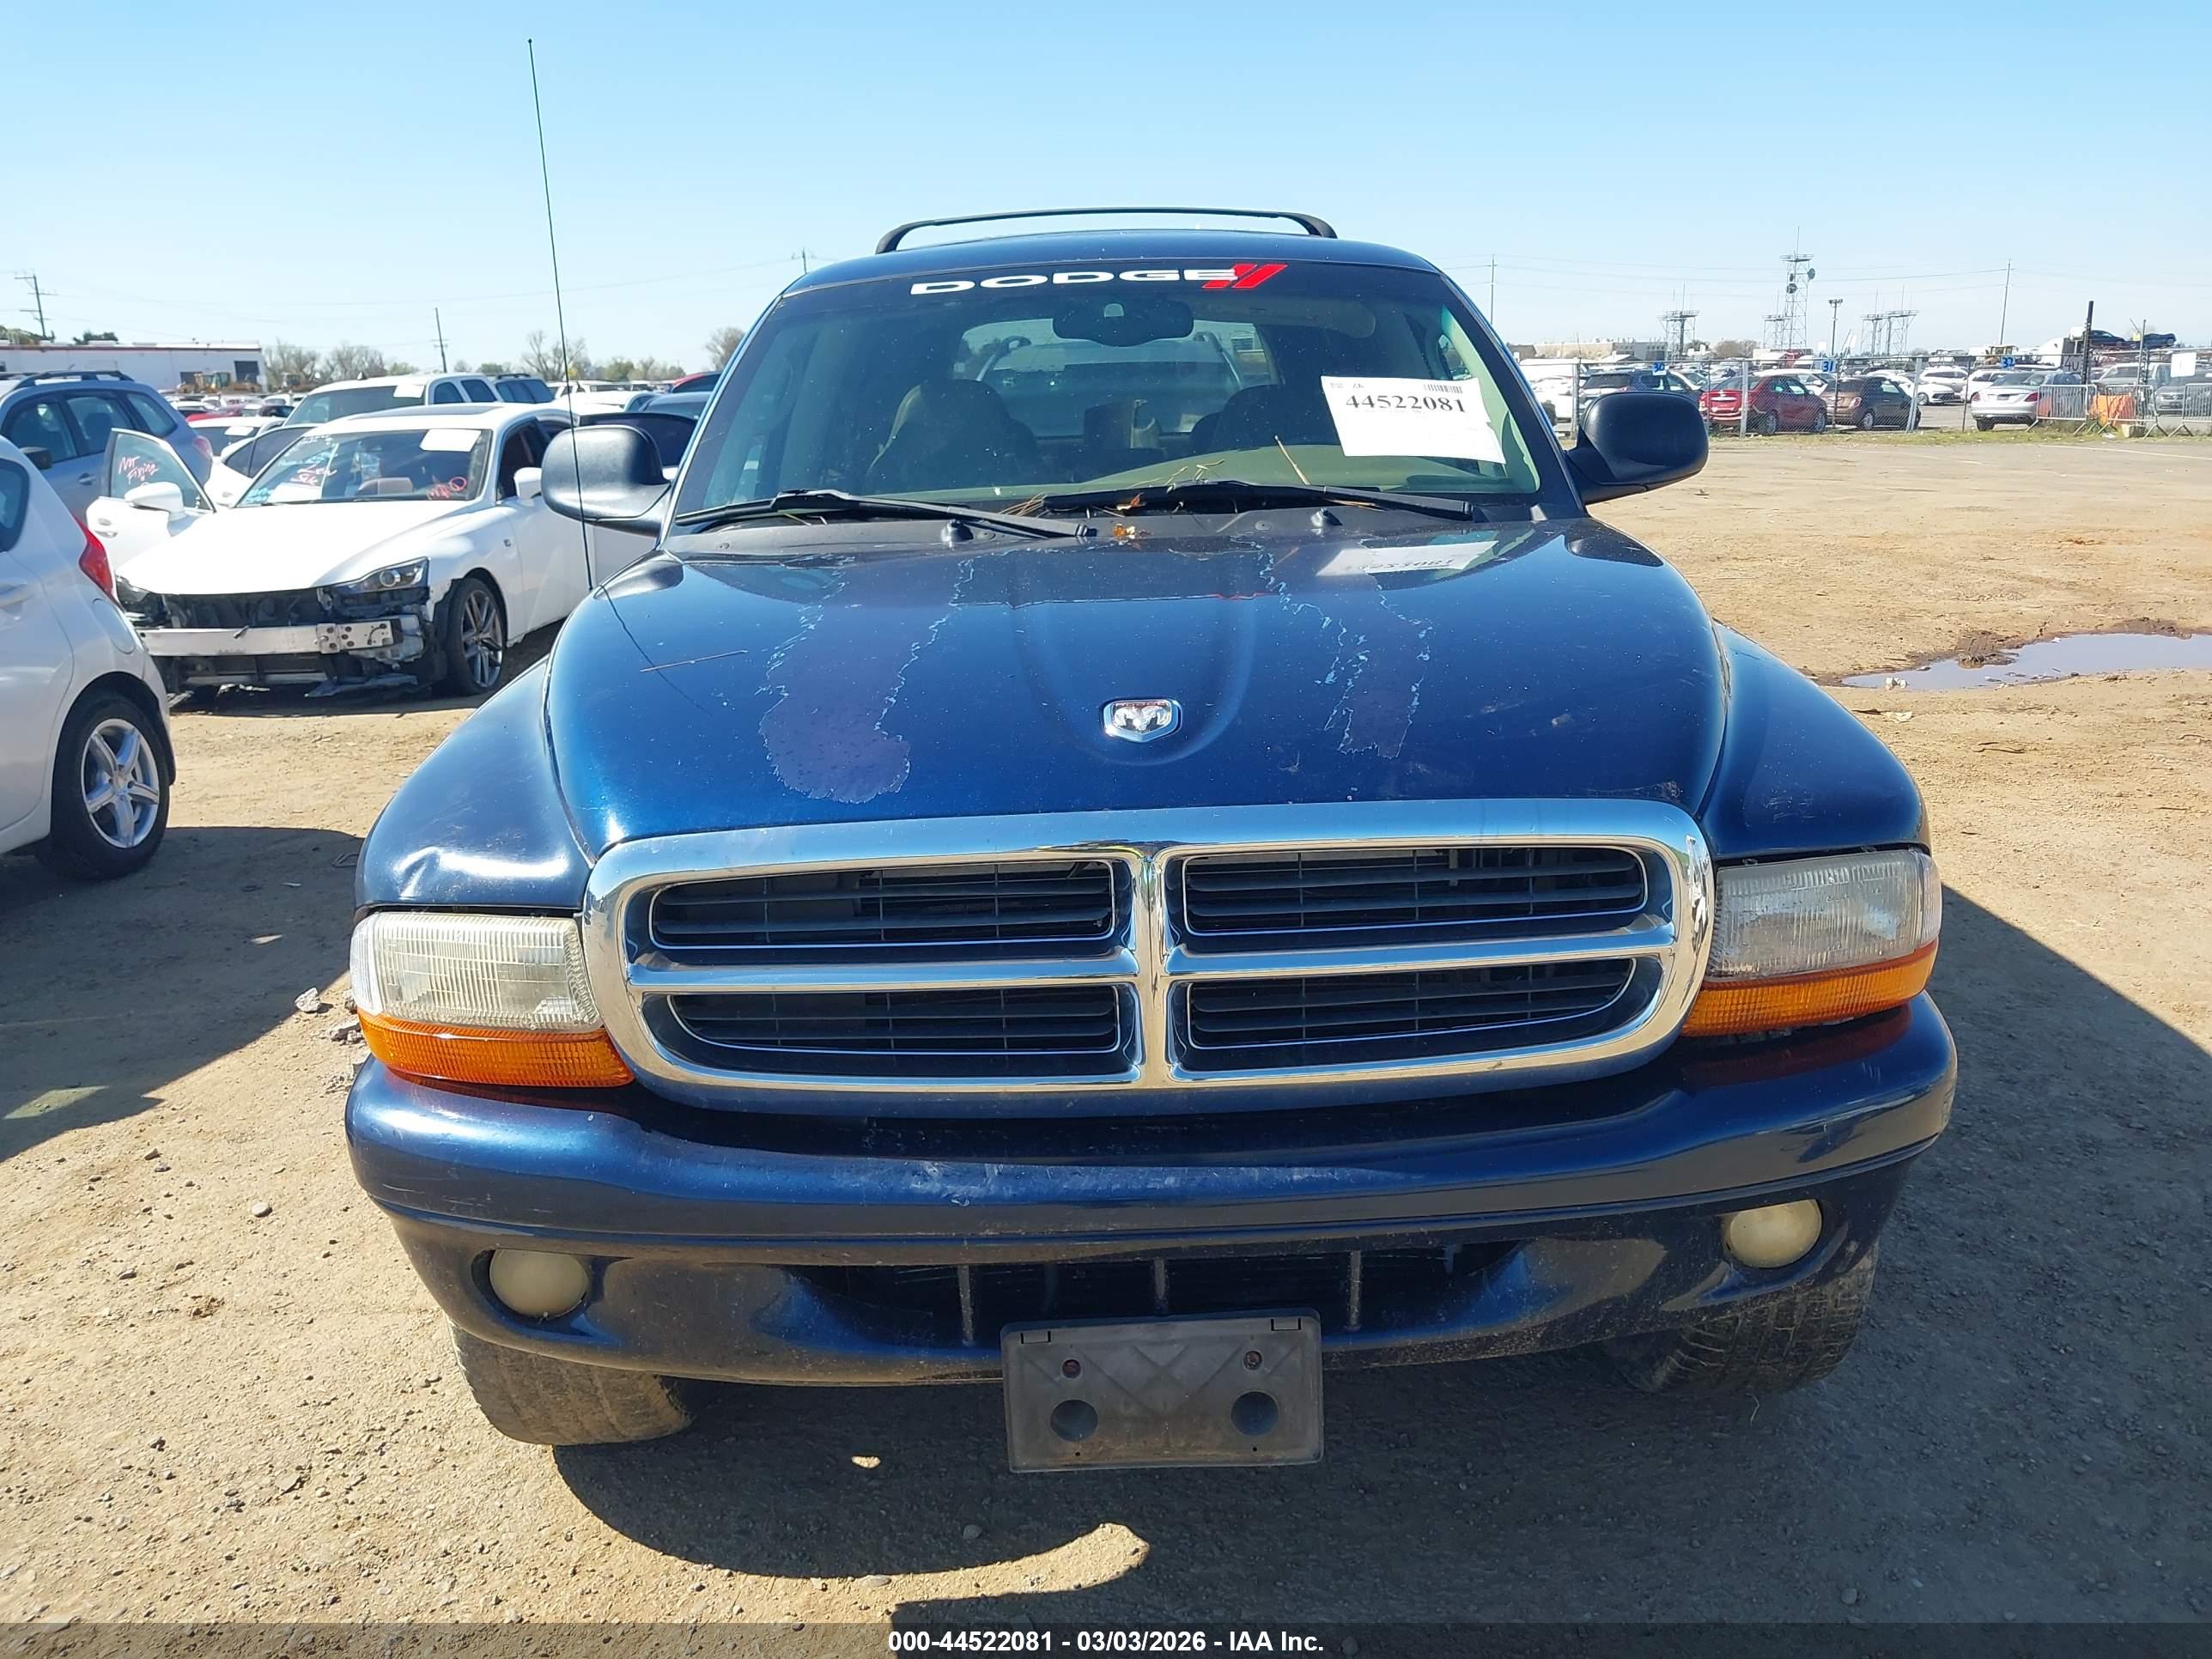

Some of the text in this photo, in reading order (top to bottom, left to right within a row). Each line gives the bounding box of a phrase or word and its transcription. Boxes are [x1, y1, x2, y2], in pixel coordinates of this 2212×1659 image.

[910, 269, 1237, 295] DODGE
[1822, 361, 1834, 373] 31
[2002, 356, 2015, 369] 32
[1346, 394, 1466, 413] 44522081
